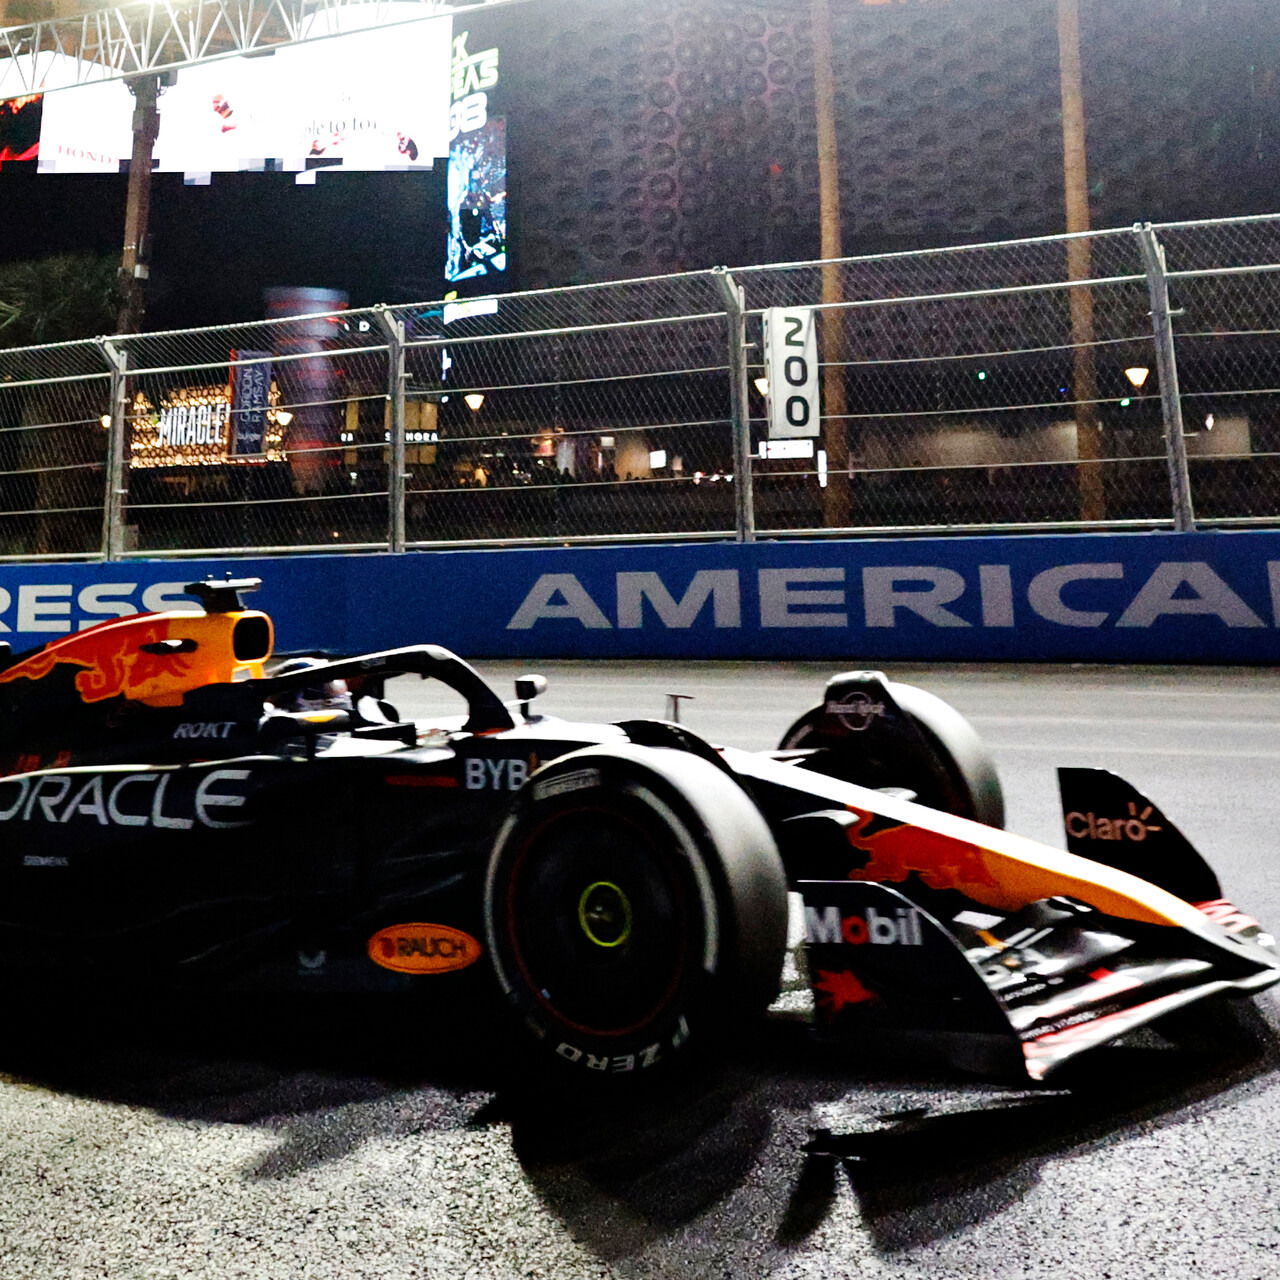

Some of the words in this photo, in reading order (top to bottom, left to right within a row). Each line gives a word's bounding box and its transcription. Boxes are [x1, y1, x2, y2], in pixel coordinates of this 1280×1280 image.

[58, 145, 120, 164] HOND
[784, 316, 810, 427] 200
[384, 431, 440, 442] SHORA
[172, 721, 238, 739] ROKT
[1065, 811, 1148, 841] Claro
[804, 906, 924, 946] Mobil
[397, 937, 468, 959] RAUCH
[555, 1041, 663, 1074] ZERO
